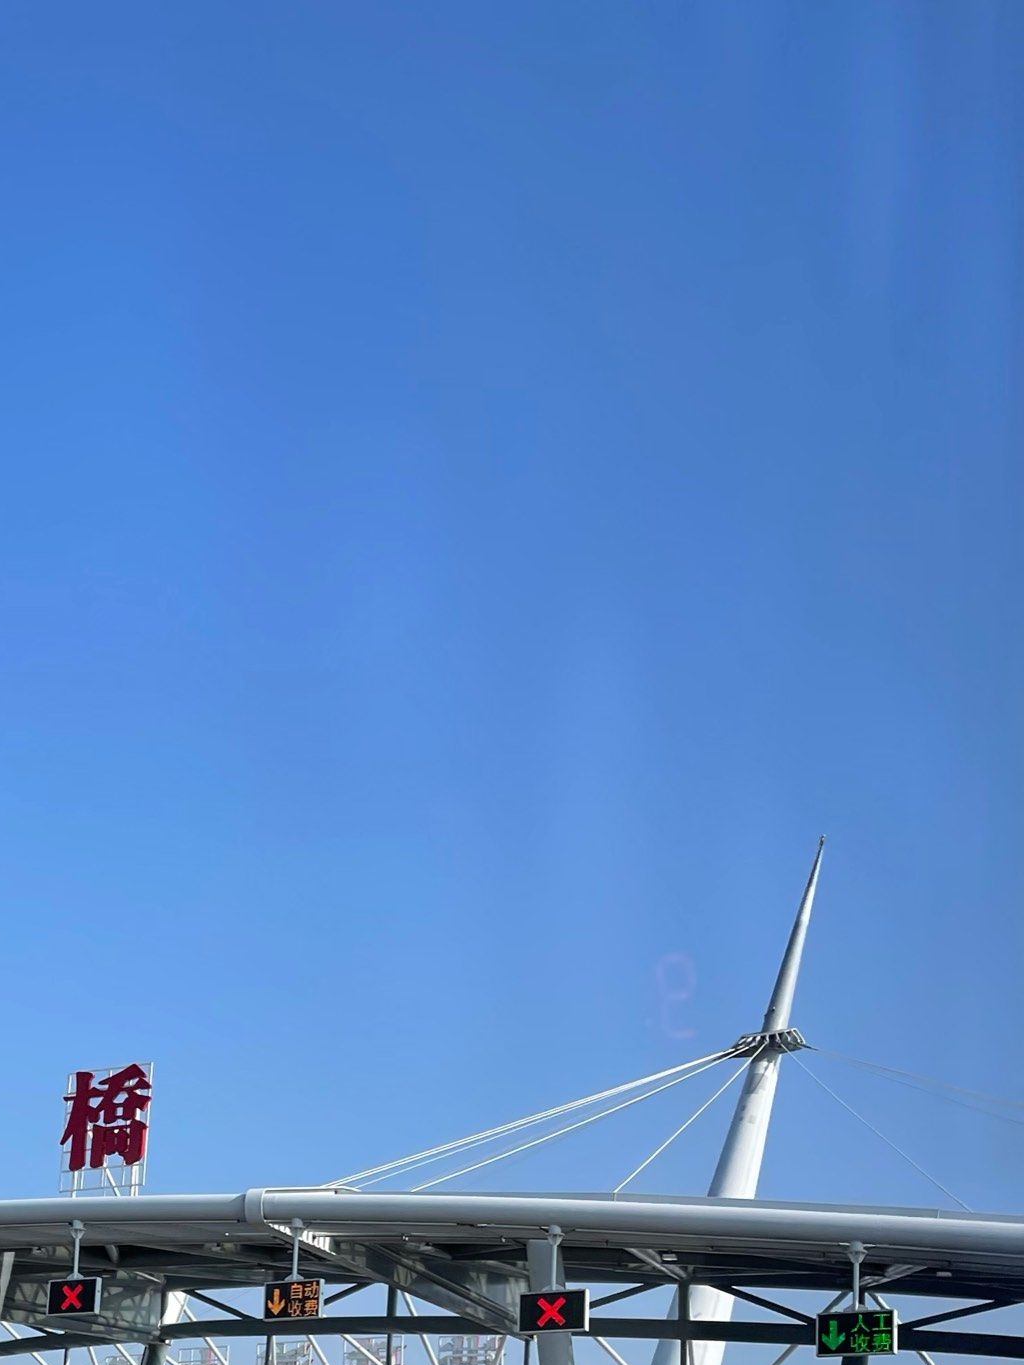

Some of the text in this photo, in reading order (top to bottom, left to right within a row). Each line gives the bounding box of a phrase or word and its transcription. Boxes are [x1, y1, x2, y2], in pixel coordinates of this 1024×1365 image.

[290, 1281, 320, 1299] 自动
[287, 1299, 318, 1317] 收费
[850, 1313, 892, 1333] 人工
[850, 1333, 892, 1353] 收费
